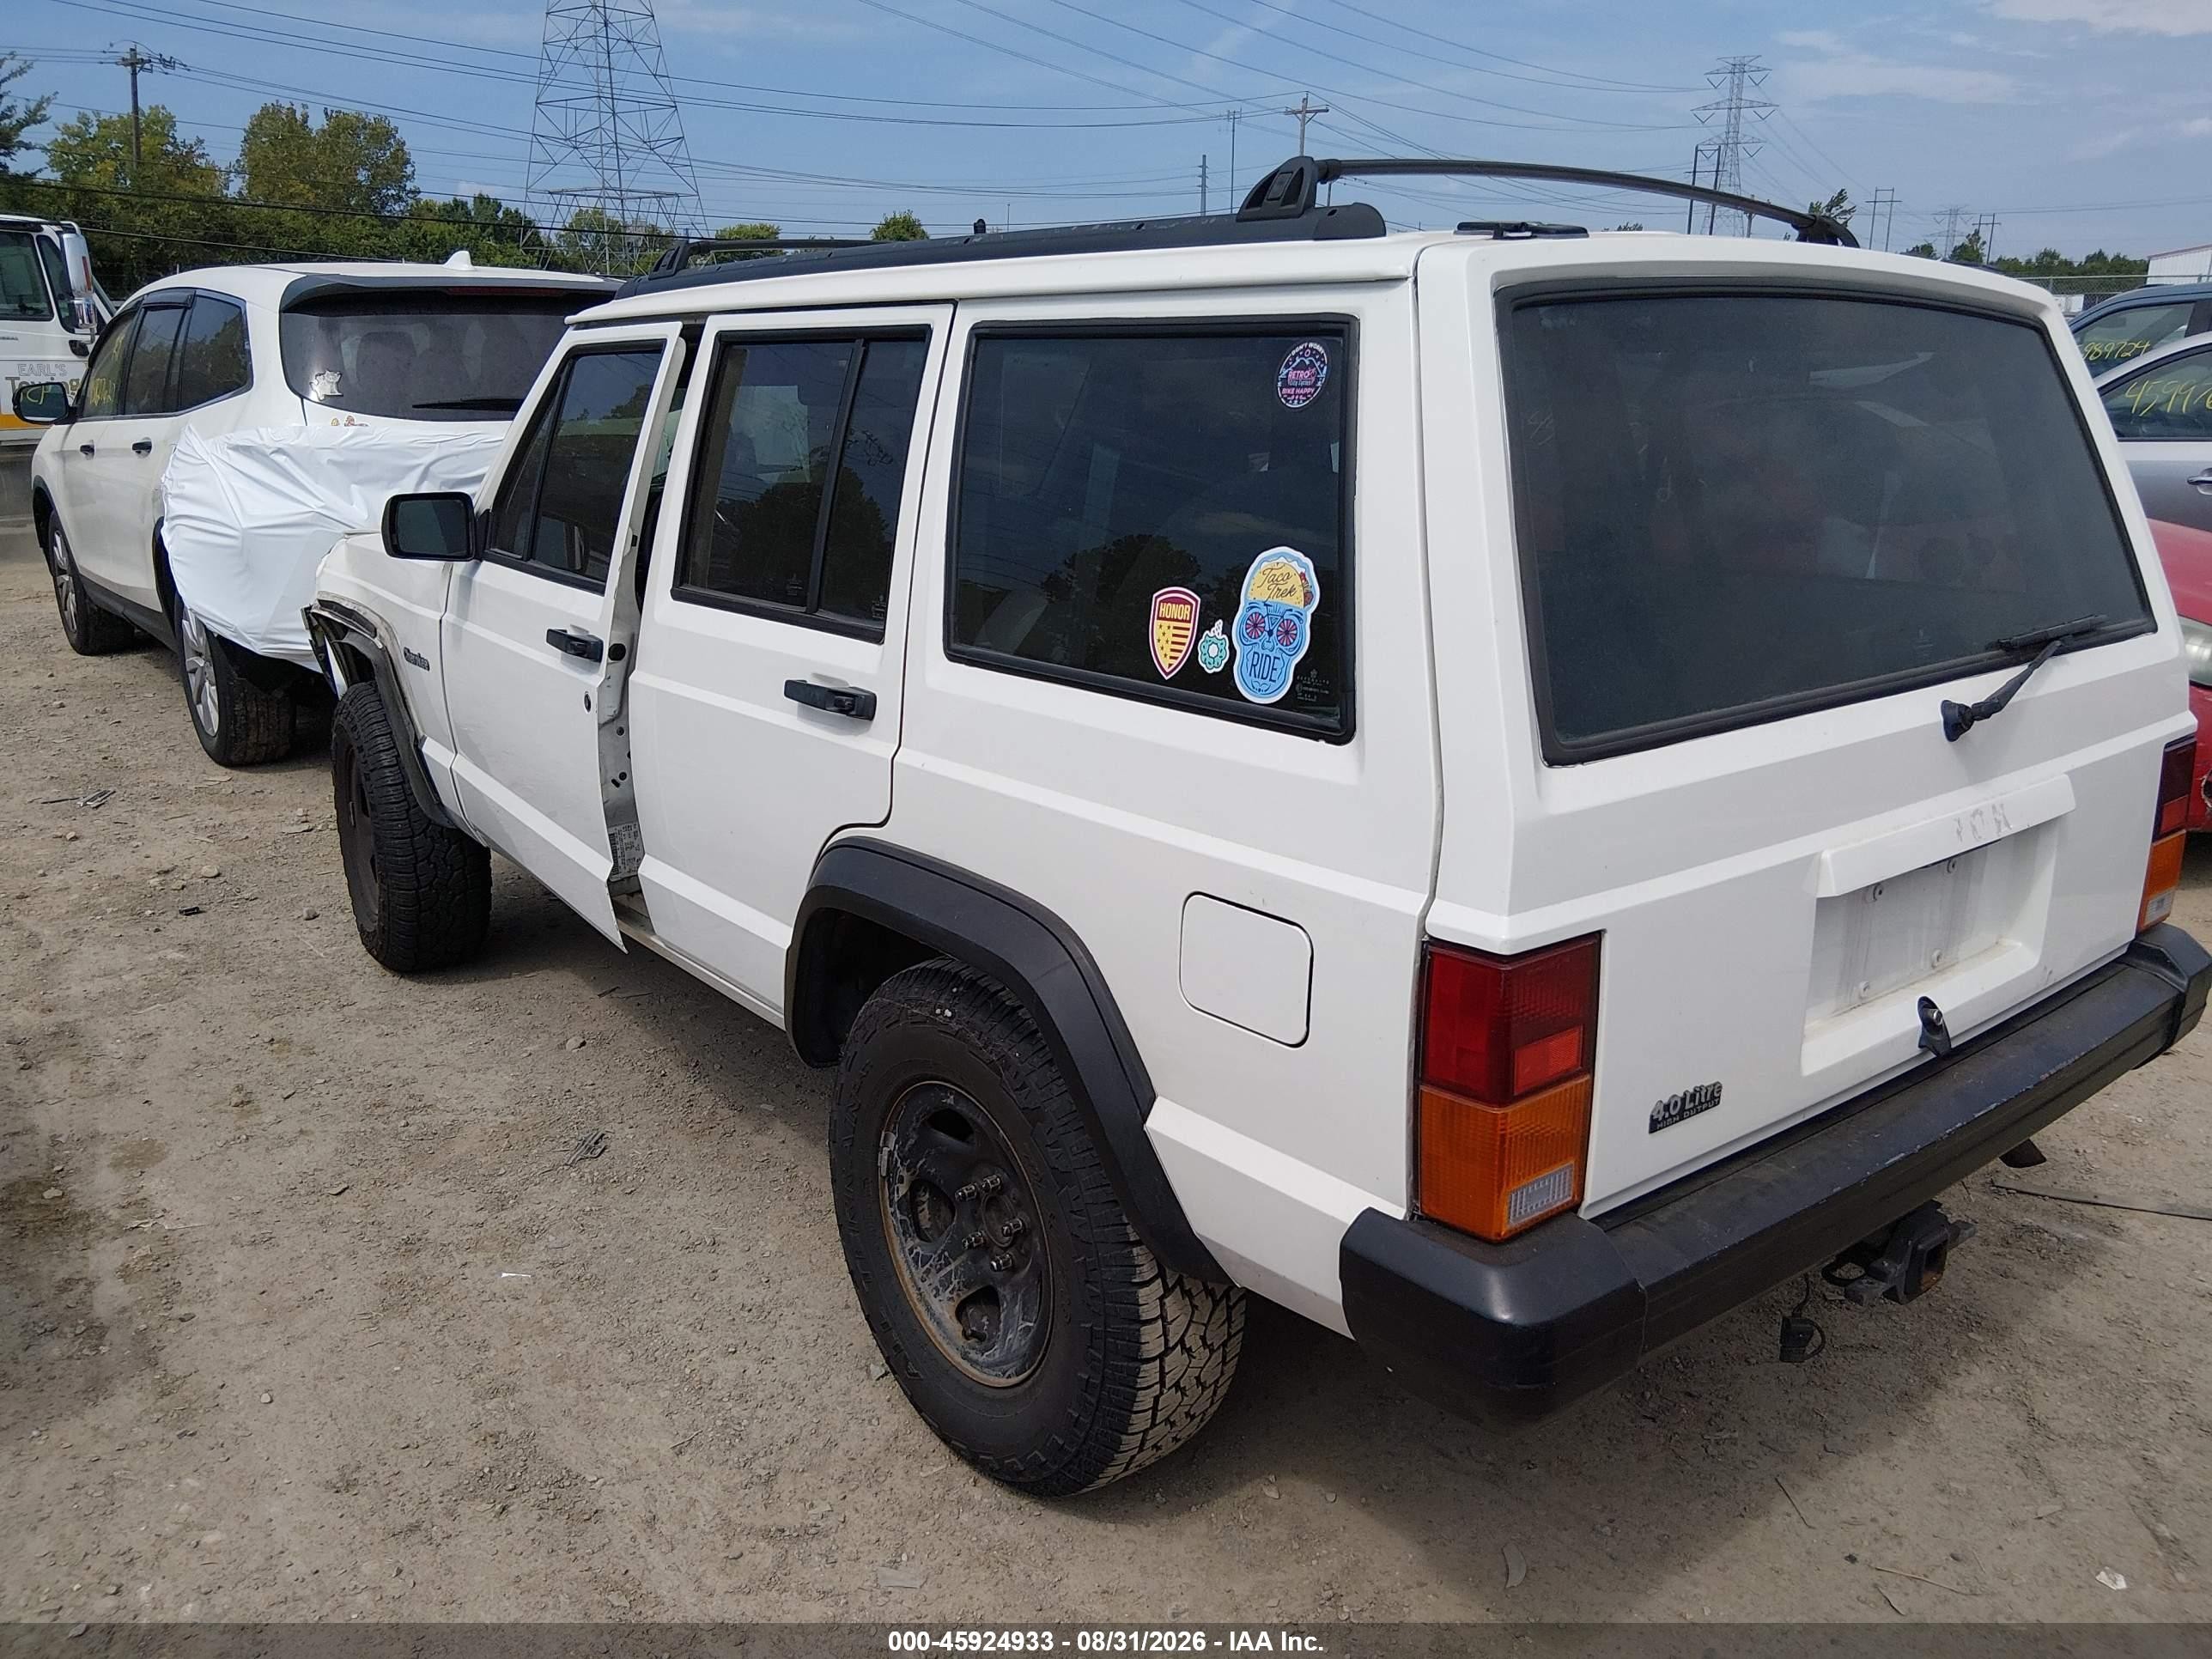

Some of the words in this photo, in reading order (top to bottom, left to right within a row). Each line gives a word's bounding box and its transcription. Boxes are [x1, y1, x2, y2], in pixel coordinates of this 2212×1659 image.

[2078, 340, 2151, 361] 989724
[17, 363, 68, 376] EARL'S
[1288, 369, 1311, 379] RETRO
[1257, 565, 1293, 589] Taco
[1263, 581, 1298, 603] Trek
[1159, 602, 1191, 621] HONOR
[1249, 651, 1280, 683] RIDE
[1651, 1095, 1682, 1121] 4.0
